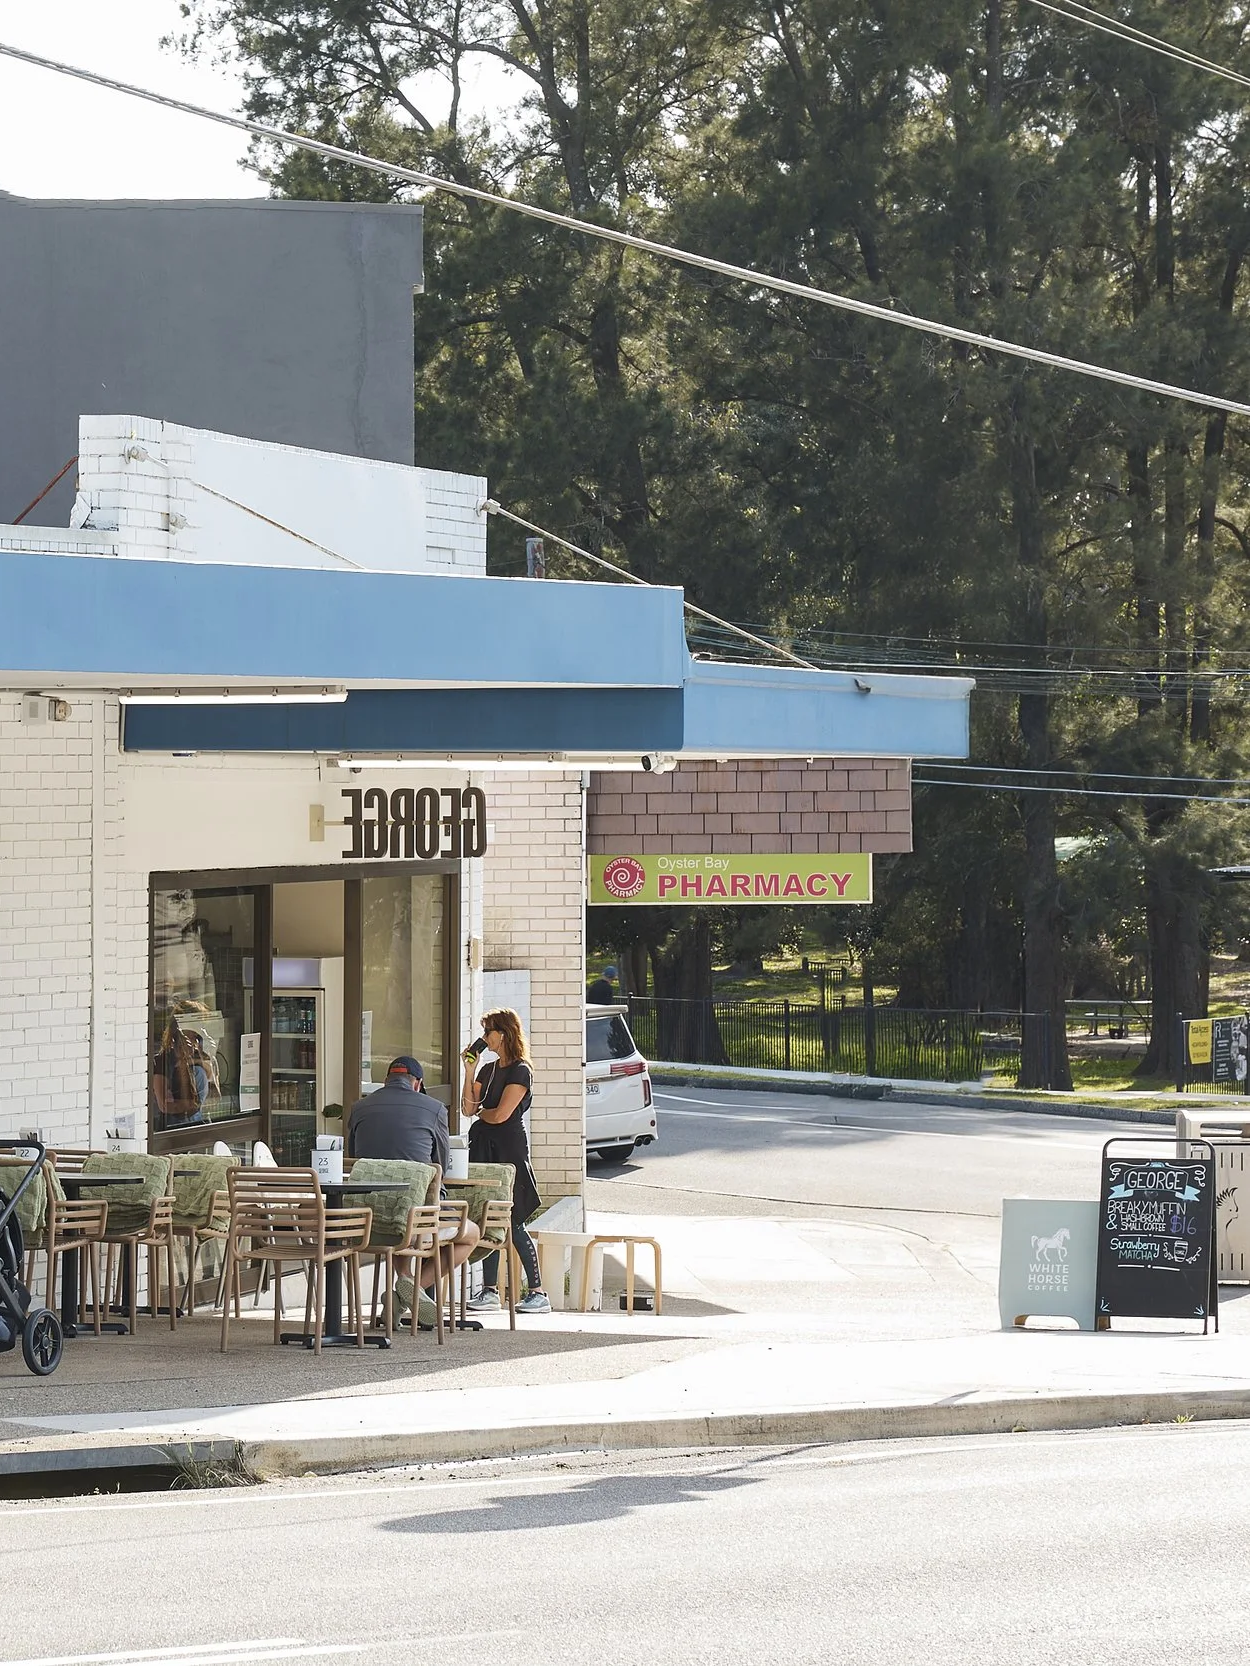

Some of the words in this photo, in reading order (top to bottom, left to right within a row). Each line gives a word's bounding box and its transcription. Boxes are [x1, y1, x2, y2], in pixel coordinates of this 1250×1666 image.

[605, 858, 631, 873] OYSTER
[630, 860, 643, 872] BAY
[657, 856, 701, 871] Oyster
[704, 856, 730, 871] Bay
[605, 878, 644, 898] PHARMACY
[657, 872, 853, 898] PHARMACY
[20, 1149, 30, 1157] 22
[318, 1157, 329, 1166] 23
[1127, 1171, 1185, 1190] GEORGE
[1105, 1213, 1118, 1230] &
[1120, 1221, 1142, 1231] SMALL
[1143, 1222, 1167, 1232] COFFEE
[1170, 1214, 1197, 1235] $16
[1110, 1237, 1160, 1258] Strawberry
[1118, 1249, 1153, 1261] MATCHA
[1029, 1263, 1069, 1274] WHITE
[1028, 1274, 1069, 1285] HORSE
[1027, 1284, 1069, 1292] COFFEE
